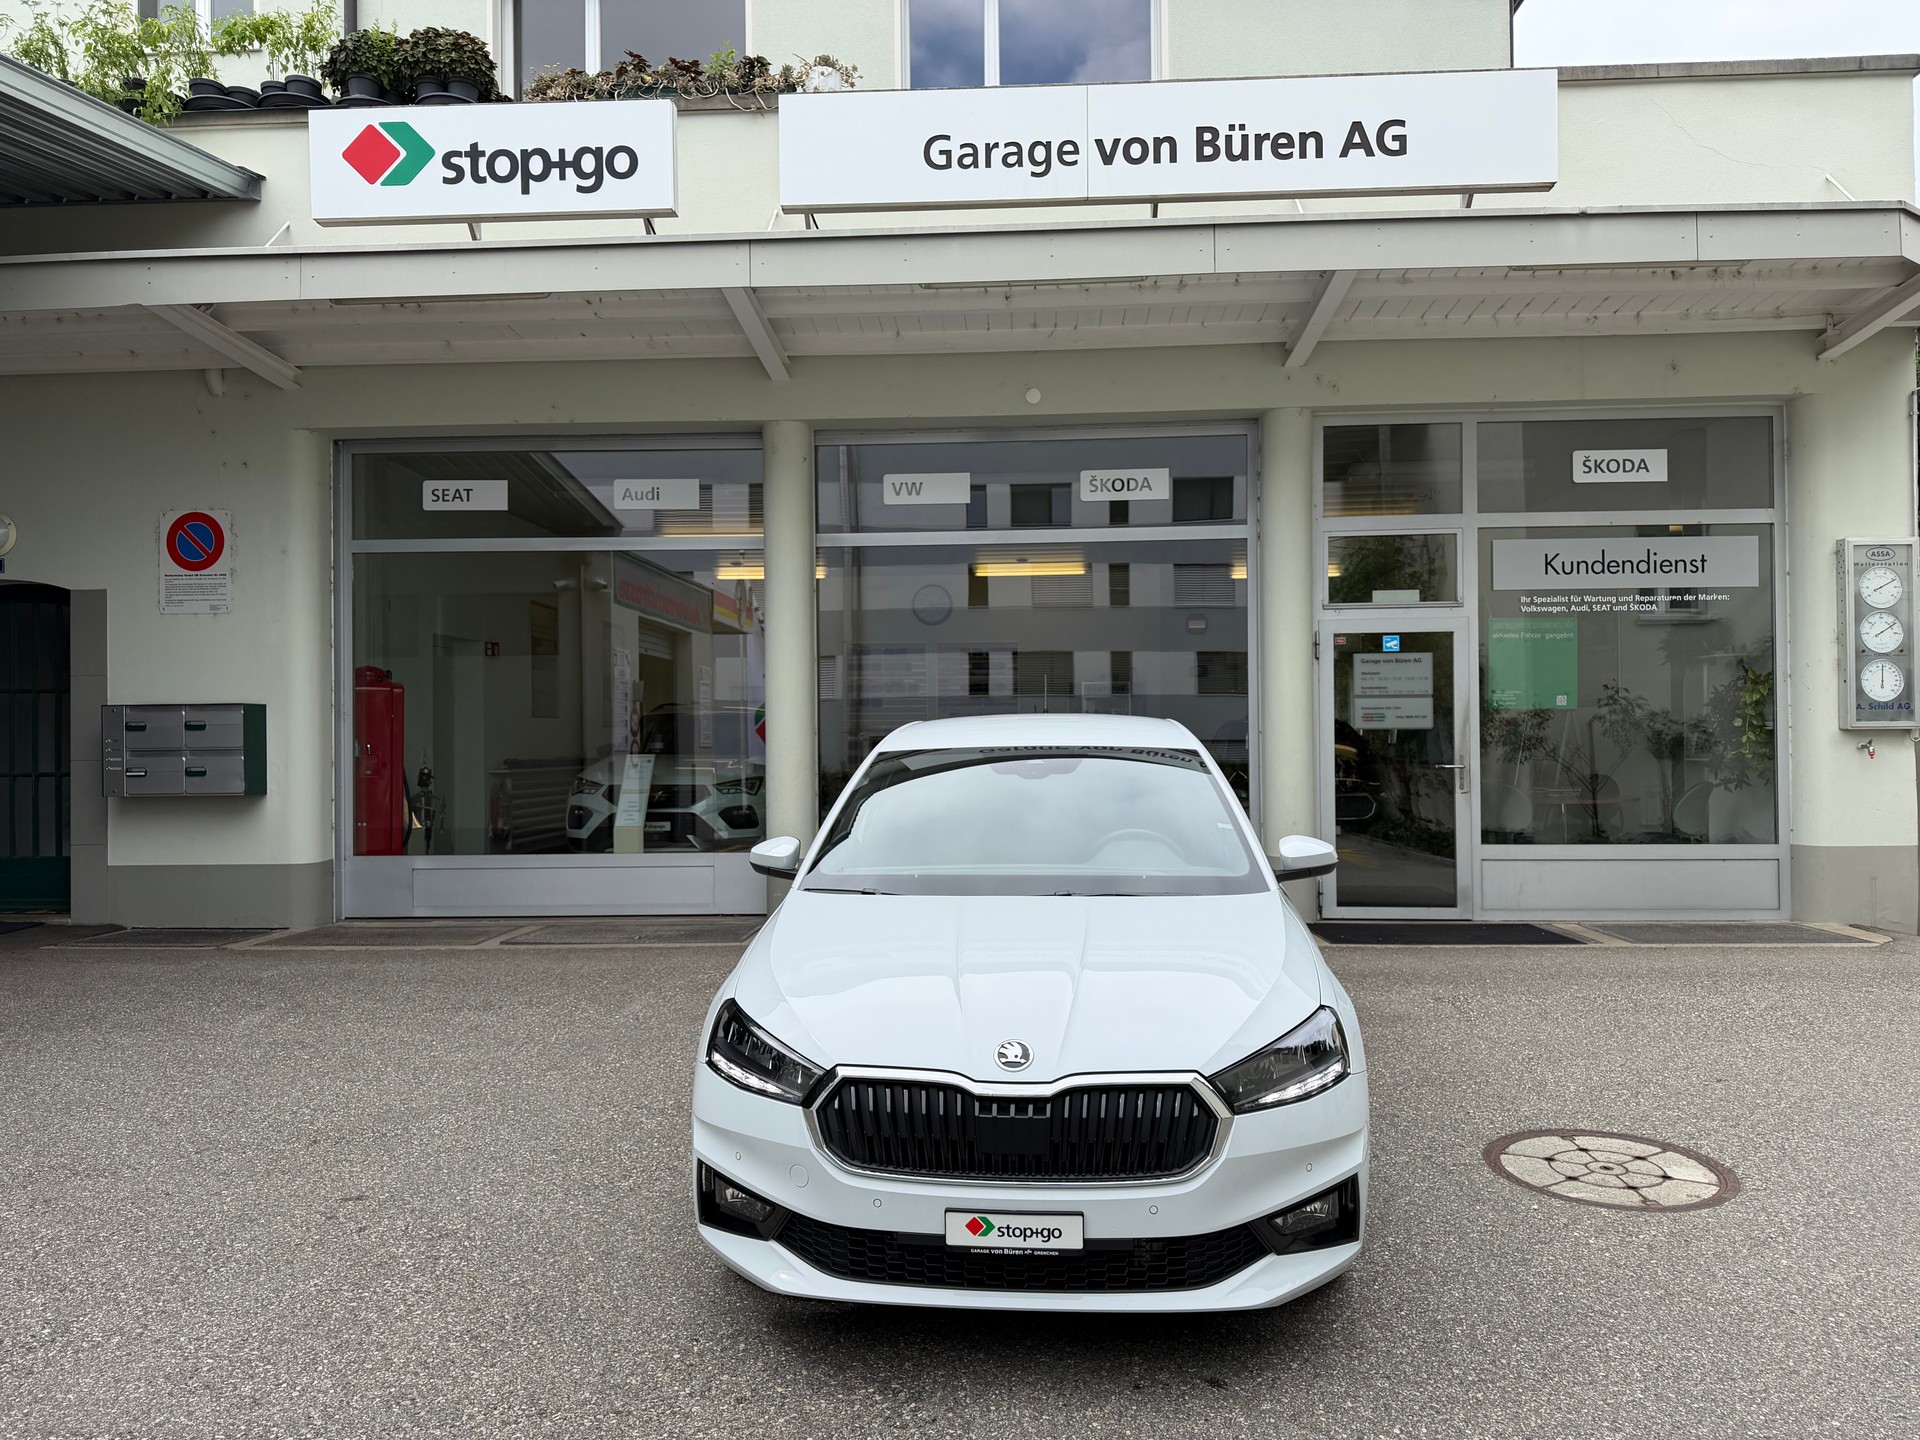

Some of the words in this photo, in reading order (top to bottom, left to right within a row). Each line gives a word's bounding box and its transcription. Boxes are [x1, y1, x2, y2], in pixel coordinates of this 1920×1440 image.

[923, 134, 1080, 178] Garage
[1094, 135, 1178, 166] von
[1195, 123, 1324, 163] Büren
[1338, 118, 1408, 158] AG
[442, 141, 639, 195] stop+go
[1583, 455, 1650, 474] ŠKODA
[891, 481, 924, 496] VW
[1089, 474, 1153, 493] ŠKODA
[431, 488, 474, 503] SEAT
[622, 486, 660, 501] Audi
[1544, 549, 1708, 576] Kundendienst
[1533, 595, 1569, 604] Spezialist
[1570, 594, 1582, 602] für
[1583, 594, 1617, 604] Wartung
[1618, 594, 1634, 602] und
[1635, 594, 1682, 603] Reparaturen
[1683, 593, 1697, 601] der
[1698, 593, 1730, 601] Marken:
[1520, 605, 1569, 613] Volkswagen,
[1570, 604, 1591, 612] Audi,
[1629, 603, 1658, 611] ŠKODA
[1868, 702, 1894, 710] Schild
[1897, 702, 1911, 710] AG
[997, 1224, 1063, 1243] stop+go
